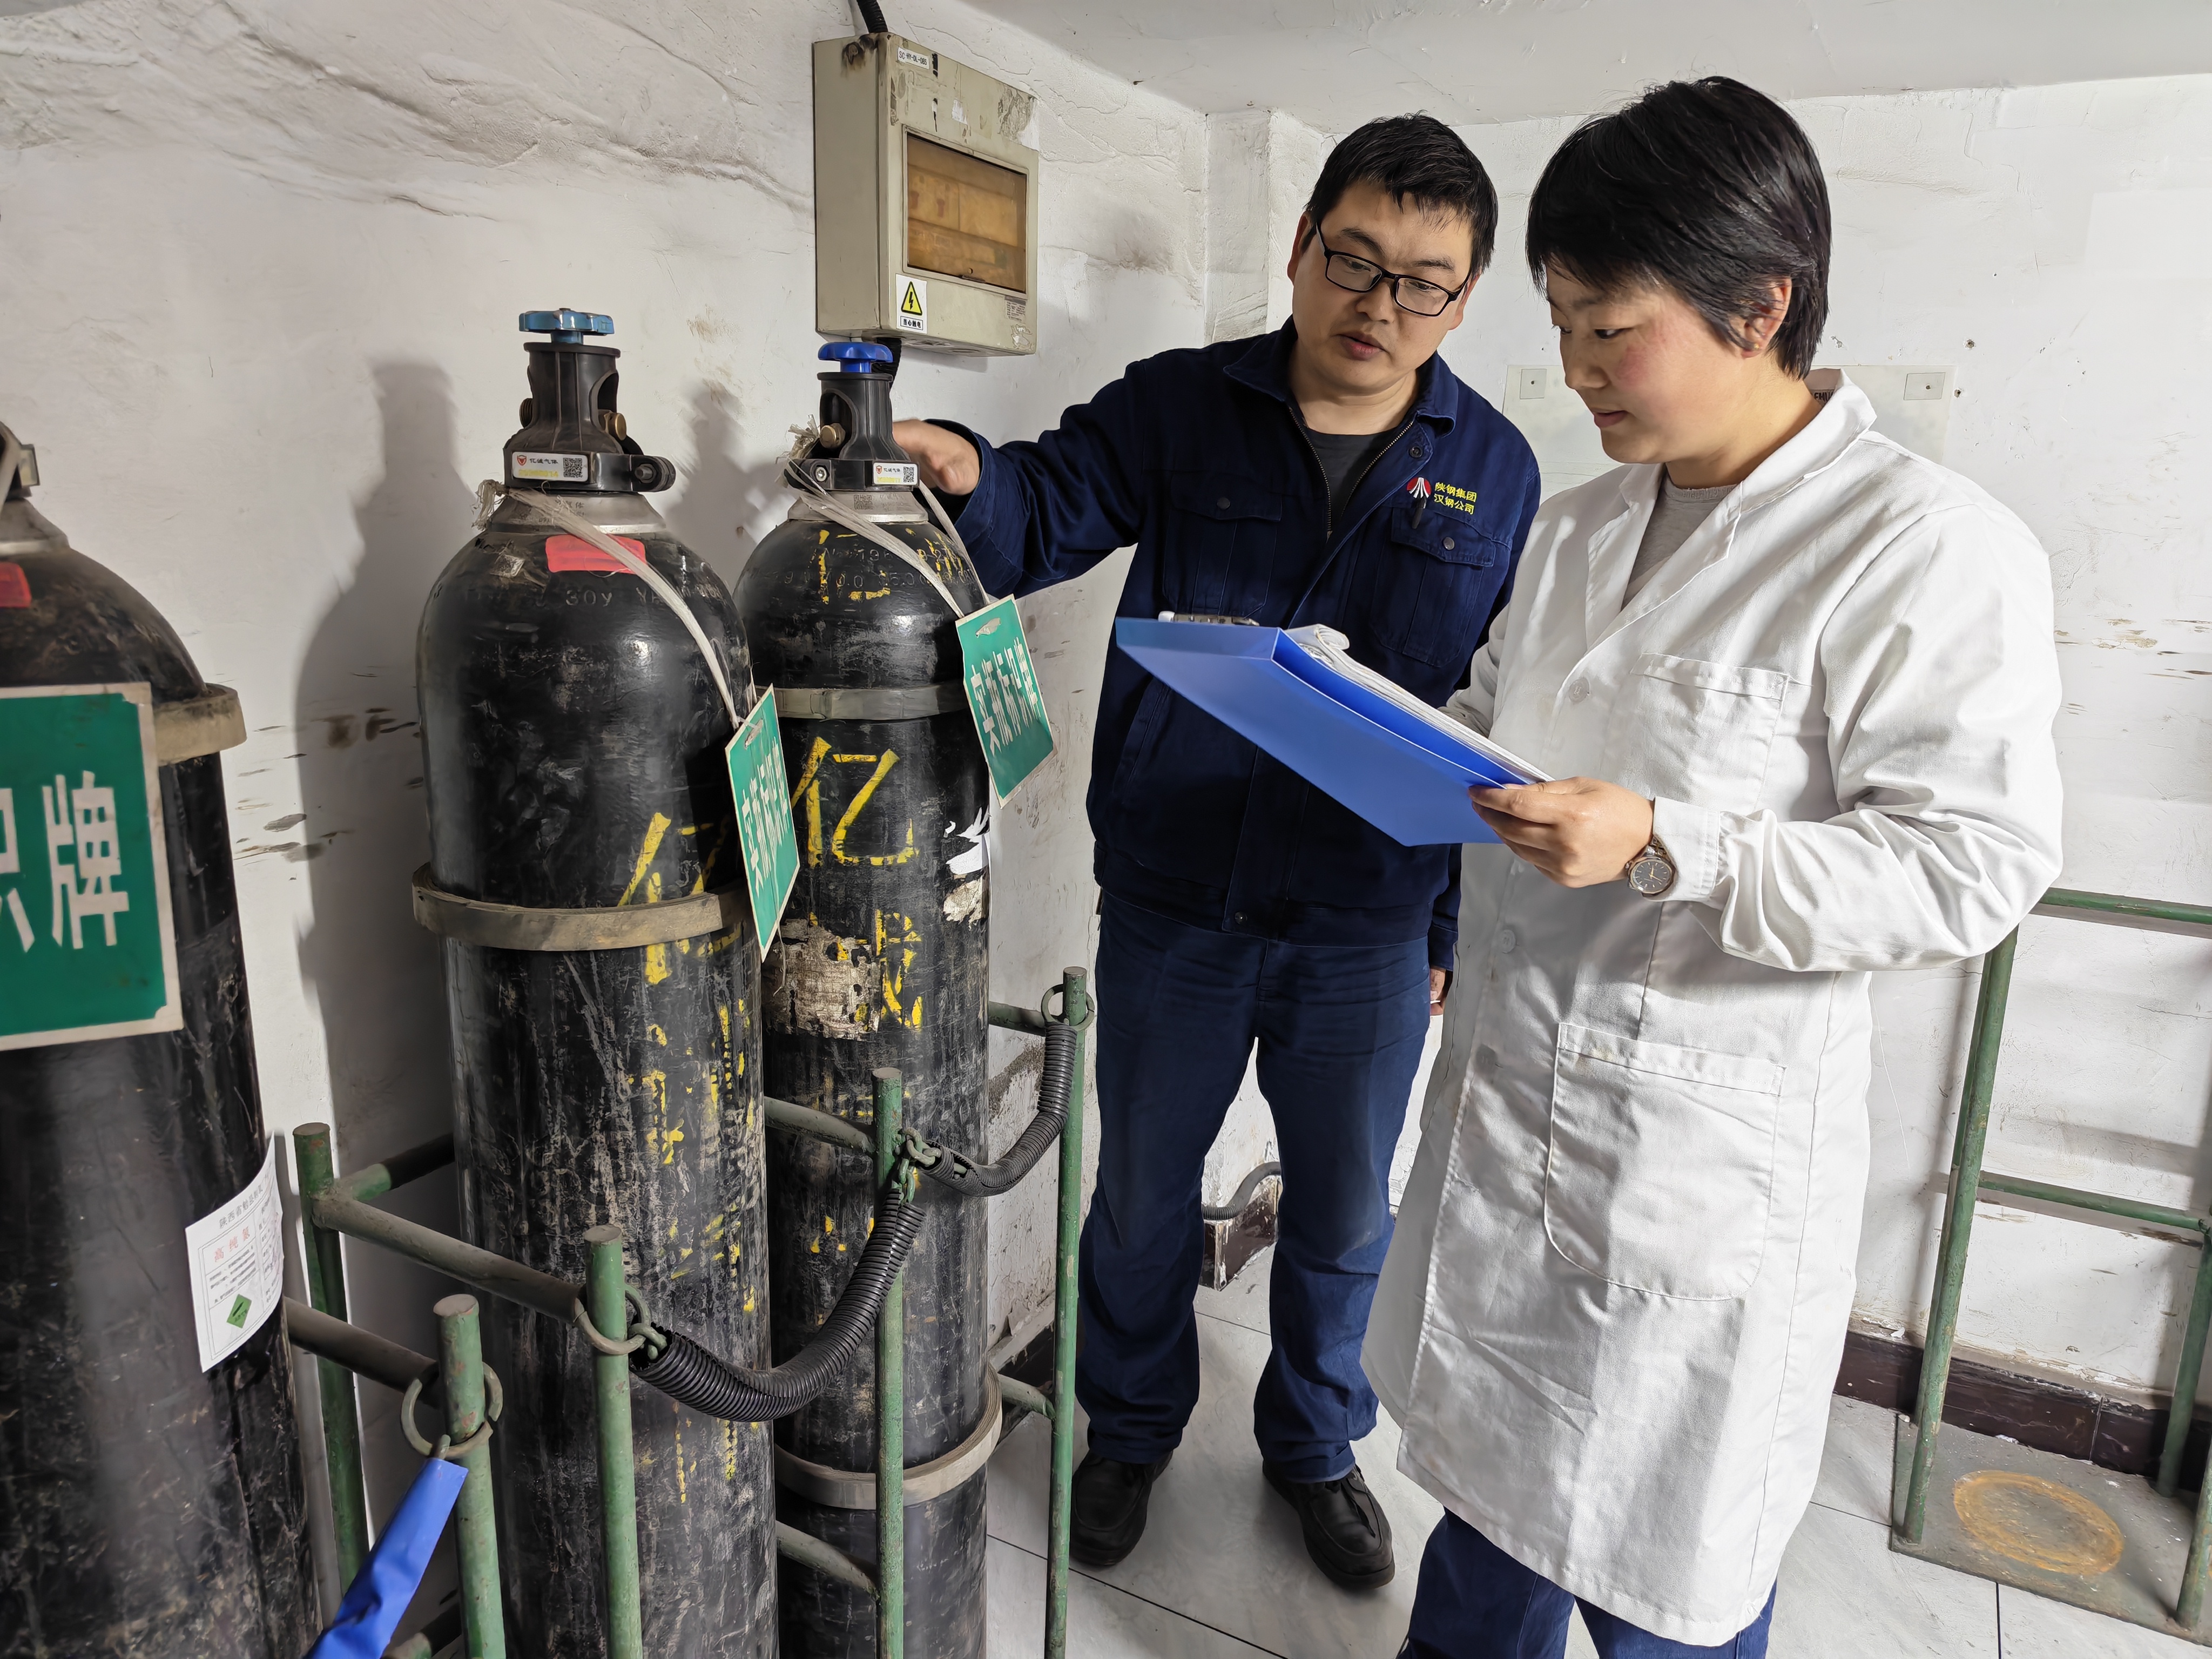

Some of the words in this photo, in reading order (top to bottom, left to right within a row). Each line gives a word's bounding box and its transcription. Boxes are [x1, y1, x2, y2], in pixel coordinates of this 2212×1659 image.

[903, 318, 921, 328] 当心触电
[1435, 482, 1477, 503] 陕钢集团
[1434, 493, 1474, 515] 汉钢公司
[970, 637, 1041, 757] 实瓶标识牌
[742, 736, 790, 899] 实瓶标识牌
